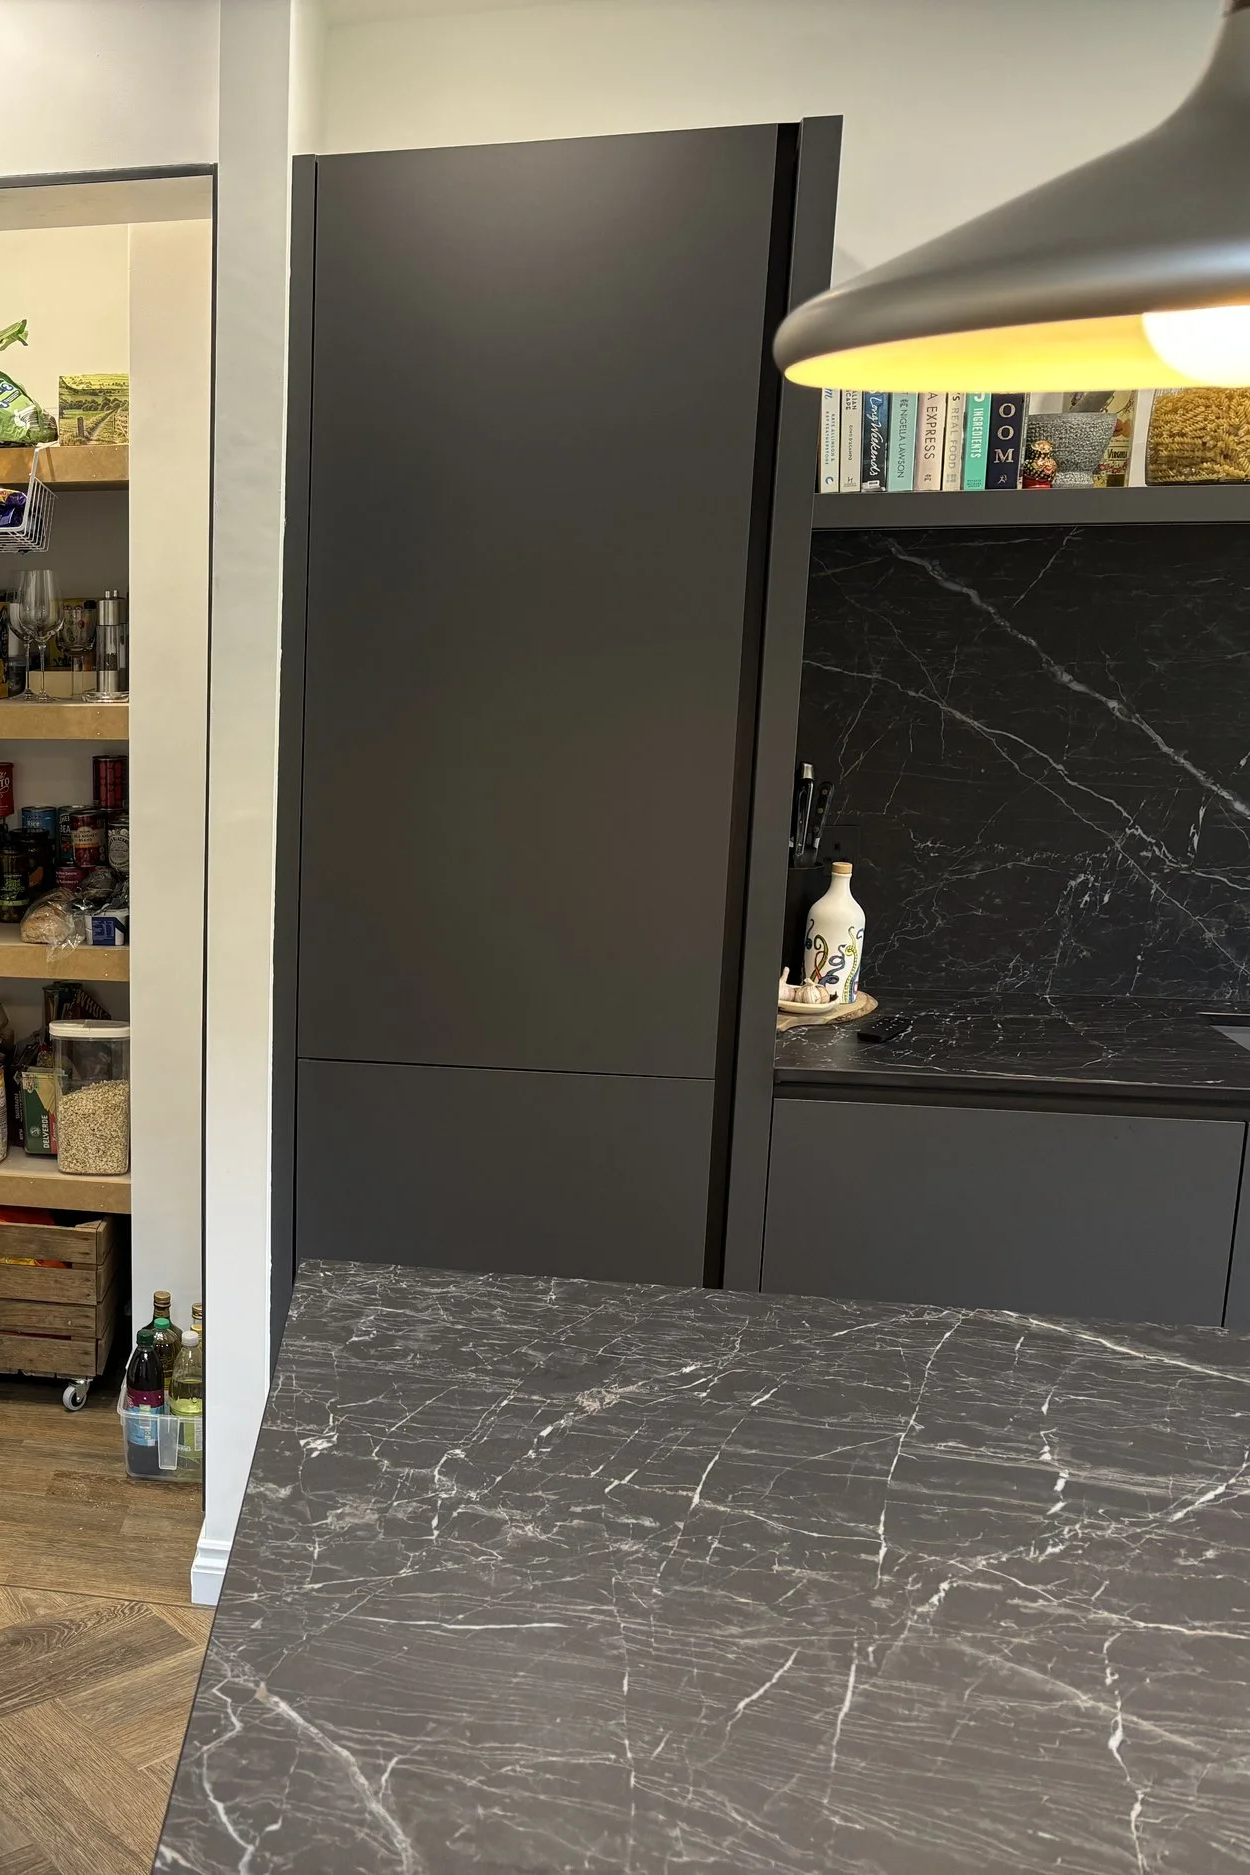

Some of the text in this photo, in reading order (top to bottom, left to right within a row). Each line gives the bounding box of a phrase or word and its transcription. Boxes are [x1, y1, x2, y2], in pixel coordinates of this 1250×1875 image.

[867, 396, 882, 421] Long
[950, 407, 959, 435] REAL
[869, 421, 884, 476] Weekends
[897, 408, 908, 478] NIGELLA LAWSON
[924, 406, 938, 460] EXPRESS
[948, 439, 958, 469] FOOD
[970, 407, 984, 459] INGREDIENTS
[40, 1114, 51, 1149] DELVERDE
